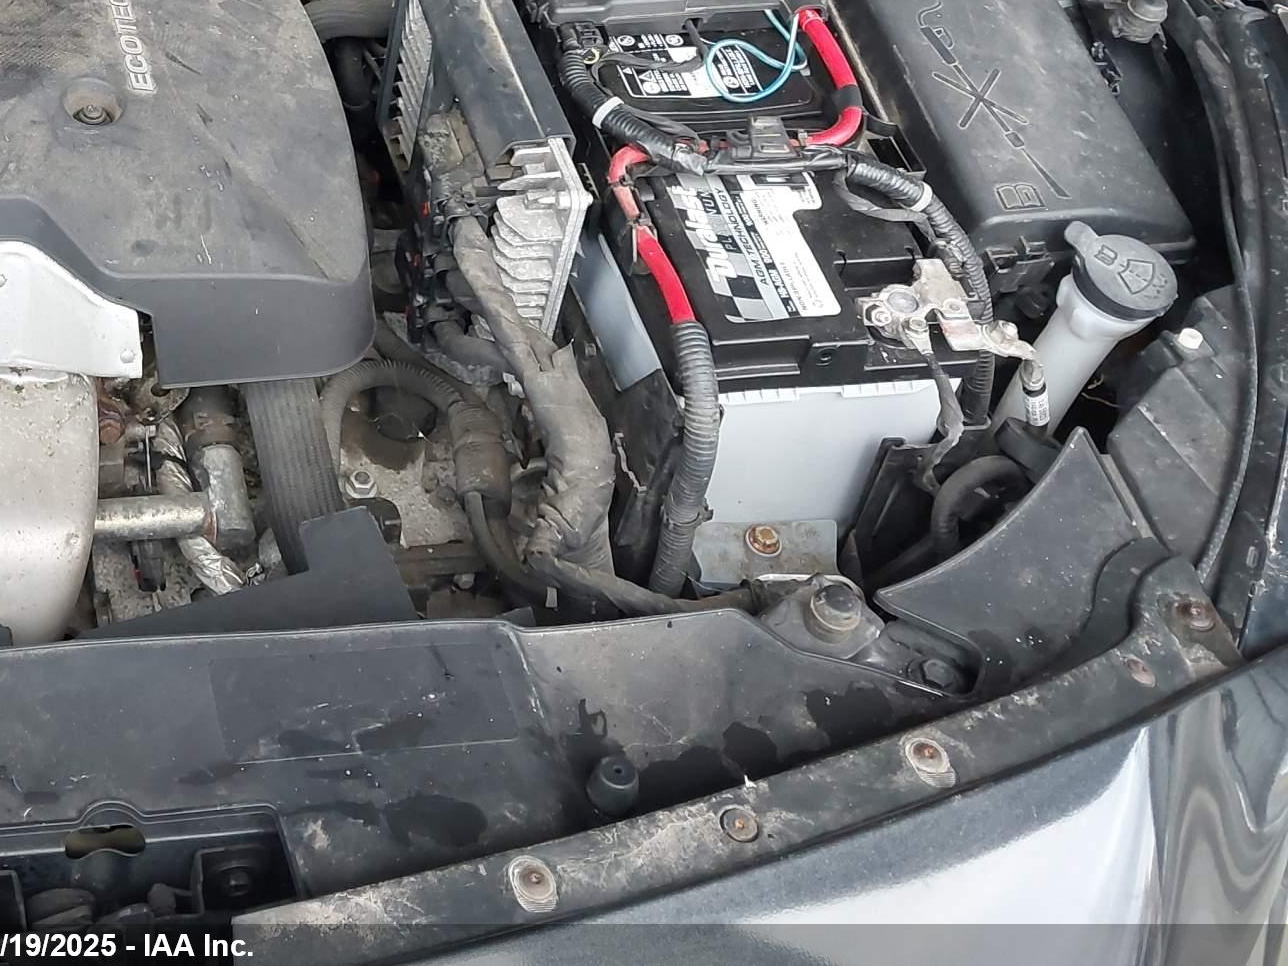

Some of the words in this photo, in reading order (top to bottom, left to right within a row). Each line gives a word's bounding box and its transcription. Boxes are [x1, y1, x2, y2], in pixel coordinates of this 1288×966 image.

[673, 184, 738, 283] Duralast
[714, 186, 754, 258] TECHNOLOGY
[752, 257, 770, 286] AGM
